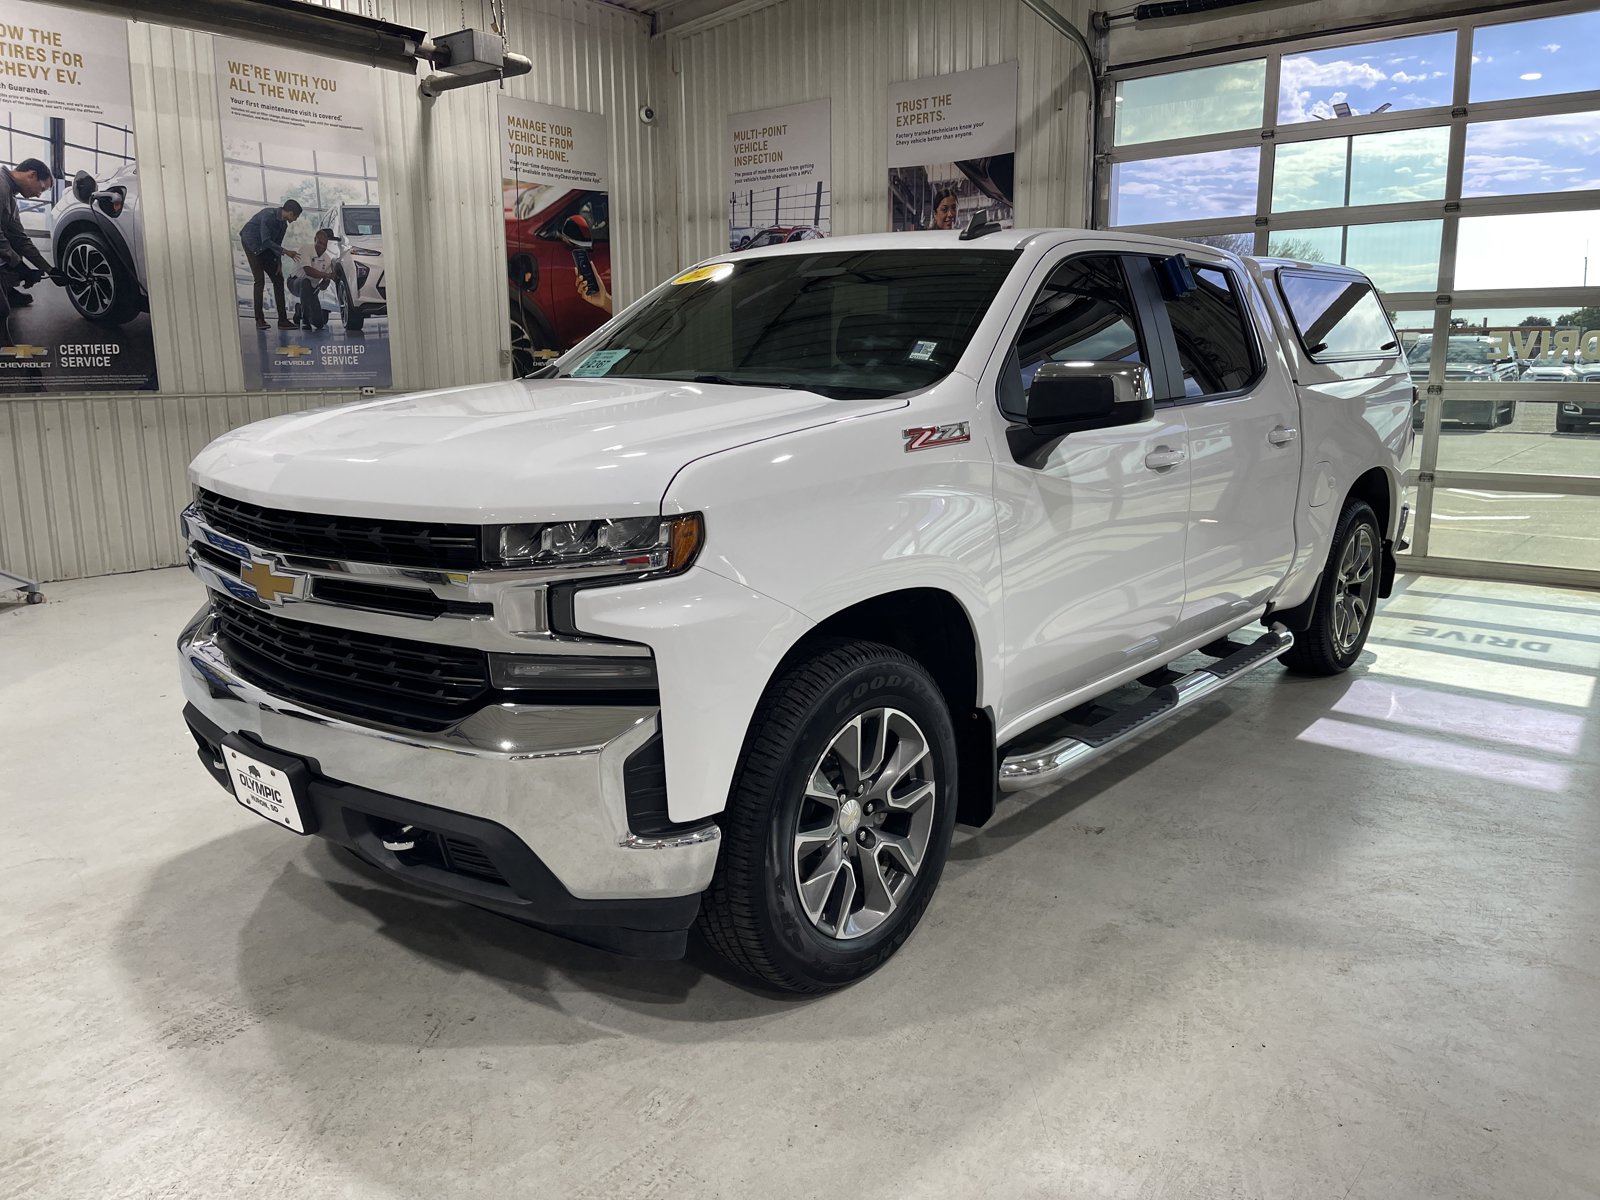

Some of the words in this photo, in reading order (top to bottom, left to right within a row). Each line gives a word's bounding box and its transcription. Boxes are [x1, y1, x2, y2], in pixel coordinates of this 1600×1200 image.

[29, 29, 62, 47] THE
[0, 42, 46, 62] TIRES
[52, 50, 83, 68] FOR
[56, 69, 81, 86] EV.
[228, 60, 271, 80] WE'RE
[275, 70, 308, 87] WITH
[312, 77, 337, 92] YOU
[9, 84, 50, 96] Guarantee.
[230, 78, 255, 94] ALL
[258, 83, 284, 99] THE
[288, 88, 318, 104] WAY.
[230, 97, 244, 105] Your
[246, 100, 259, 108] first
[261, 104, 298, 114] maintenance
[896, 98, 928, 113] TRUST
[932, 94, 952, 107] THE
[508, 115, 546, 133] MANAGE
[549, 124, 572, 137] YOUR
[896, 111, 946, 127] EXPERTS.
[508, 129, 547, 146] VEHICLE
[550, 137, 574, 150] FROM
[734, 125, 788, 142] MULTI-POINT
[509, 142, 533, 157] YOUR
[536, 148, 568, 162] PHONE.
[734, 140, 768, 154] VEHICLE
[734, 151, 783, 167] INSPECTION
[541, 165, 563, 173] diagnostics
[60, 344, 120, 355] CERTIFIED
[320, 345, 365, 354] CERTIFIED
[61, 356, 111, 368] SERVICE
[321, 356, 359, 365] SERVICE
[902, 421, 970, 453] Z71
[1408, 626, 1552, 653] DRIVE
[239, 774, 282, 804] OLYMPIC
[270, 804, 279, 812] SD
